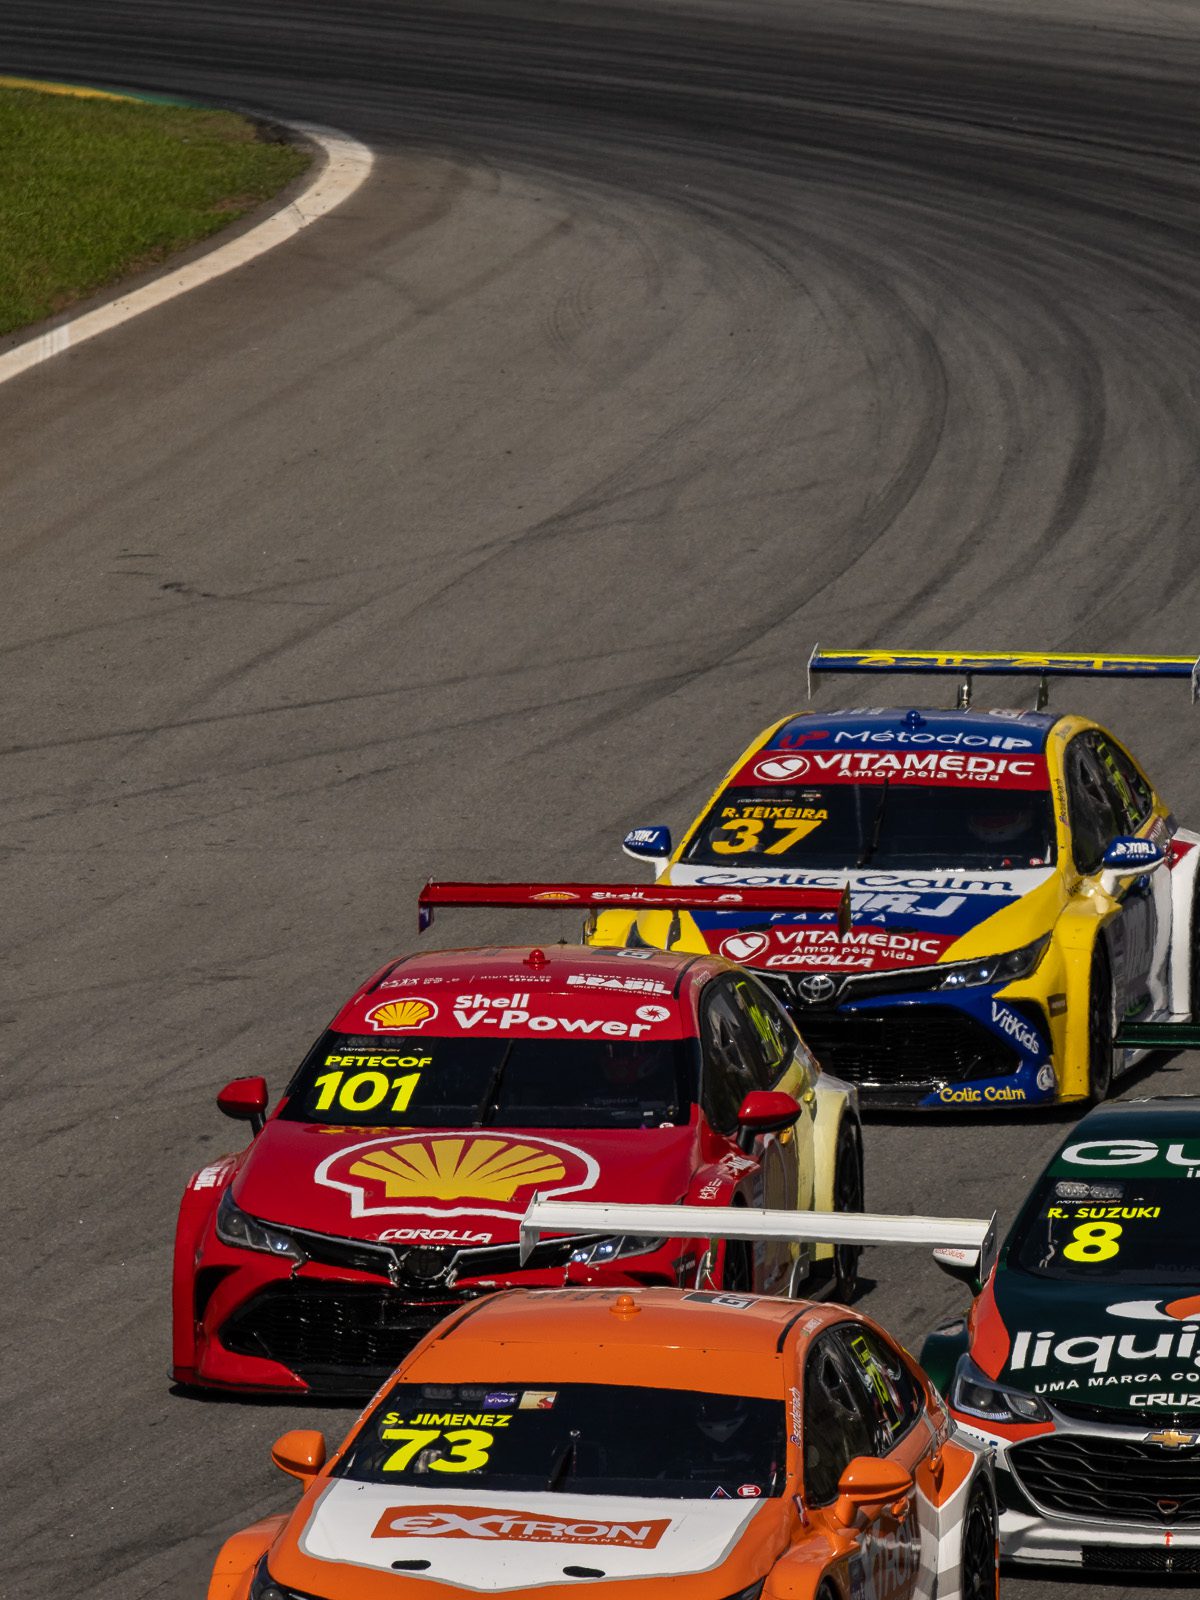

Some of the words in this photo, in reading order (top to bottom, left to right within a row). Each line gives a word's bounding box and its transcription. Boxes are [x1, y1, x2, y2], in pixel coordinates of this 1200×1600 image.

[813, 752, 1035, 777] VITAMEDIC
[837, 768, 893, 778] Amor
[902, 769, 948, 779] pela
[955, 772, 1000, 782] vida
[711, 818, 823, 855] 37
[856, 873, 1013, 892] Calm
[775, 930, 941, 955] VITAMEDIC
[765, 954, 875, 968] COROLLA
[791, 945, 837, 954] Amor
[841, 946, 876, 955] pela
[881, 949, 916, 962] vida
[566, 975, 672, 995] BRASIL
[453, 993, 530, 1010] Shell
[453, 1010, 652, 1038] V-Power
[991, 1000, 1040, 1055] VitKids
[324, 1055, 433, 1068] PETECOF
[314, 1071, 421, 1112] 101
[939, 1087, 982, 1103] Colic
[984, 1085, 1026, 1101] Calm
[1047, 1207, 1069, 1219] R.
[1074, 1207, 1161, 1219] SUZUKI
[378, 1228, 493, 1243] COROLLA
[1063, 1221, 1123, 1262] 8
[1034, 1379, 1080, 1394] UMA
[1088, 1373, 1162, 1386] MARCA
[382, 1411, 403, 1425] S.
[409, 1413, 513, 1427] JIMENEZ
[381, 1429, 494, 1473] 73
[508, 1534, 645, 1546] LUBRIFICANTES
